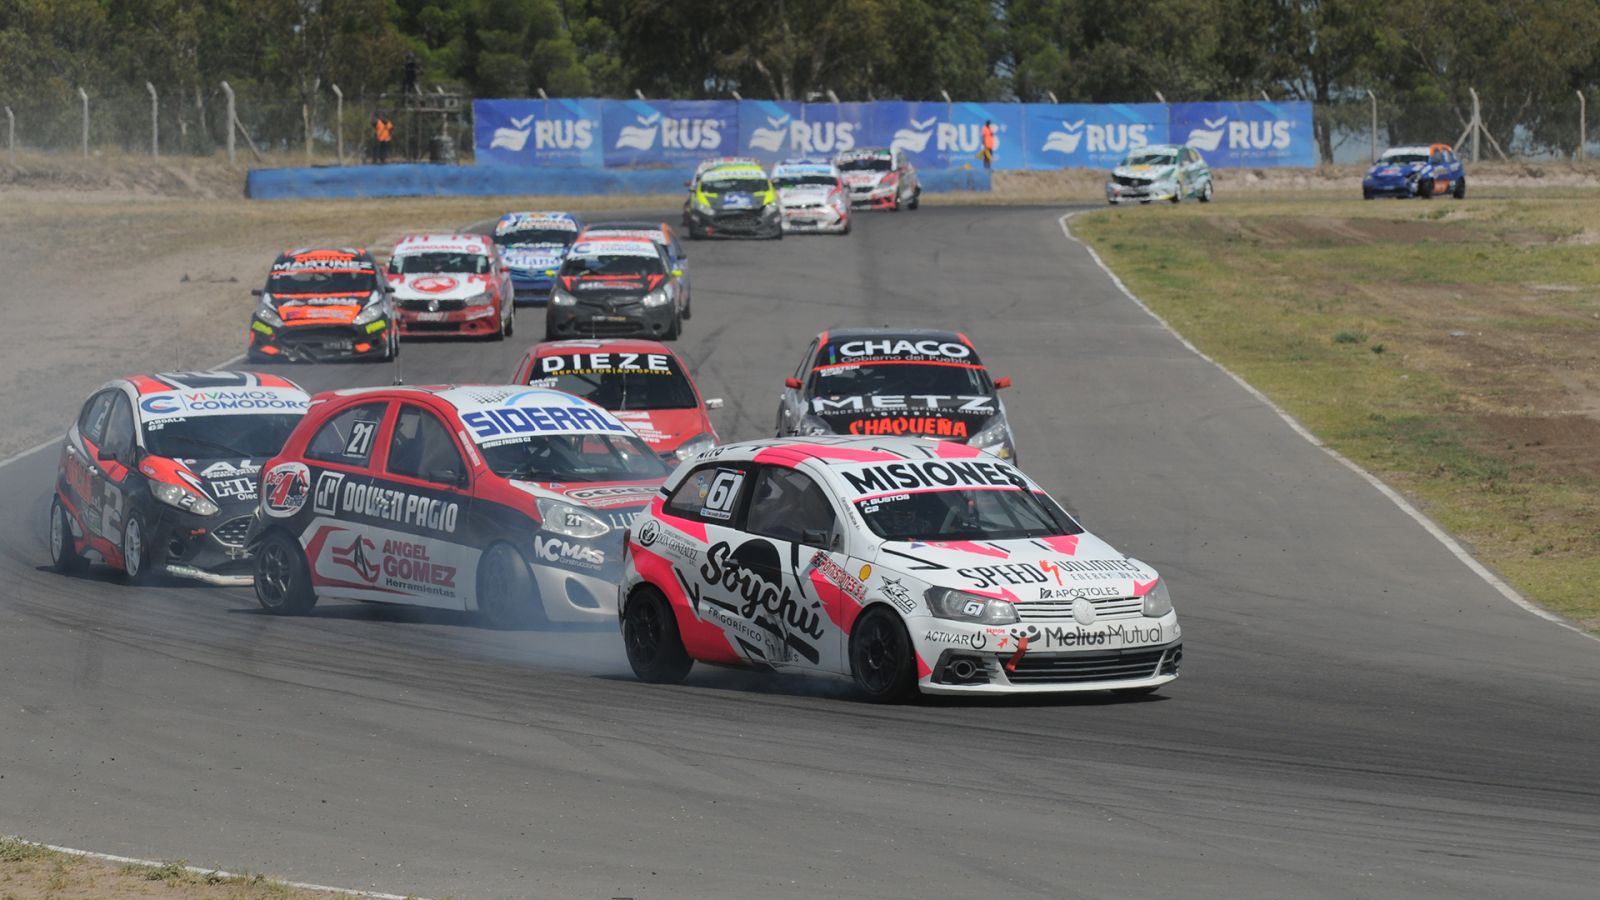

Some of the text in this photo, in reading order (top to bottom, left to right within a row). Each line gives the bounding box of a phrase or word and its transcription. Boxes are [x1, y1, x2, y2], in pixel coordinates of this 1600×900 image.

[535, 119, 593, 150] RUS
[661, 117, 723, 150] RUS
[791, 120, 856, 152] RUS
[1086, 123, 1148, 149] RUS
[1228, 120, 1290, 149] RUS
[273, 260, 373, 271] MARTINEZ
[839, 340, 970, 358] CHACO
[541, 352, 670, 373] DIEZE
[841, 355, 902, 363] Gobierno
[929, 356, 972, 365] Pueblo
[185, 391, 278, 401] VIVAMOS
[811, 394, 995, 413] METZ
[816, 406, 908, 416] CONCESIONARIO
[461, 406, 626, 438] SIDERAL
[347, 423, 374, 454] 21
[841, 461, 1027, 495] MISIONES
[181, 494, 196, 506] 2
[705, 471, 744, 511] 61
[870, 494, 910, 505] BUSTOS
[405, 494, 459, 533] PAGIO
[567, 514, 581, 526] 21
[382, 539, 430, 561] ANGEL
[383, 555, 457, 588] GOMEZ
[956, 562, 1048, 589] SPEED
[1070, 573, 1112, 581] ENERGY
[385, 577, 456, 598] Herramientas
[700, 540, 824, 641] Soychú
[1056, 586, 1120, 599] APOSTOLES
[963, 601, 985, 616] 61
[925, 630, 969, 646] ACTIVAR
